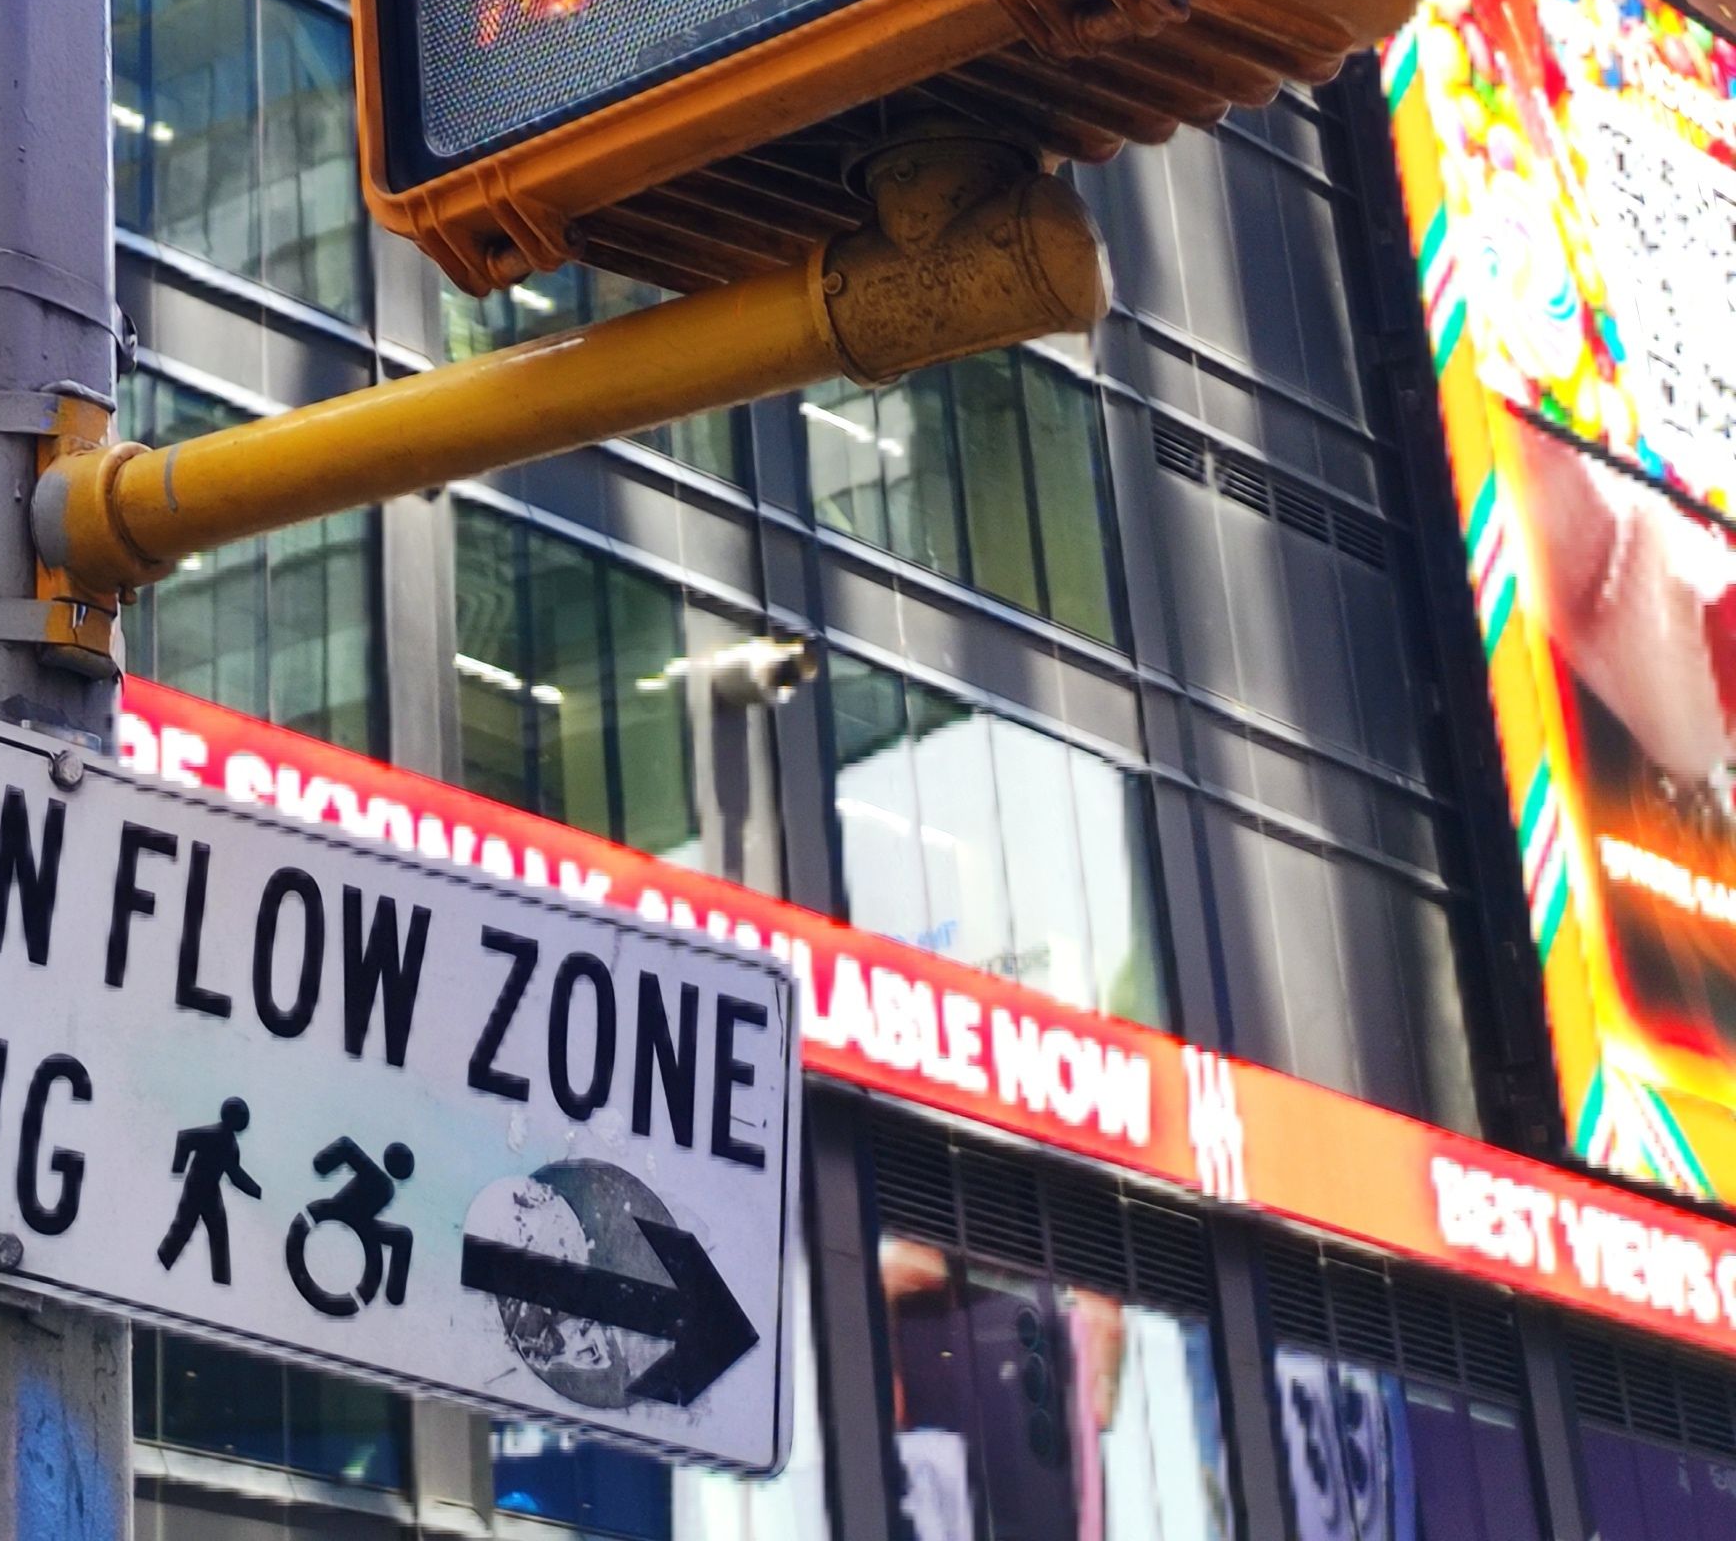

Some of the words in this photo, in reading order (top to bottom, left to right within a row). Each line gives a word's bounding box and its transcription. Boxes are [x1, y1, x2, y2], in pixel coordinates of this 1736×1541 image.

[105, 820, 432, 1068] FLOW
[468, 925, 768, 1169] ZONE
[990, 1006, 1152, 1147] NOW
[1430, 1155, 1558, 1275] BEST
[1558, 1197, 1721, 1323] VIEWS
